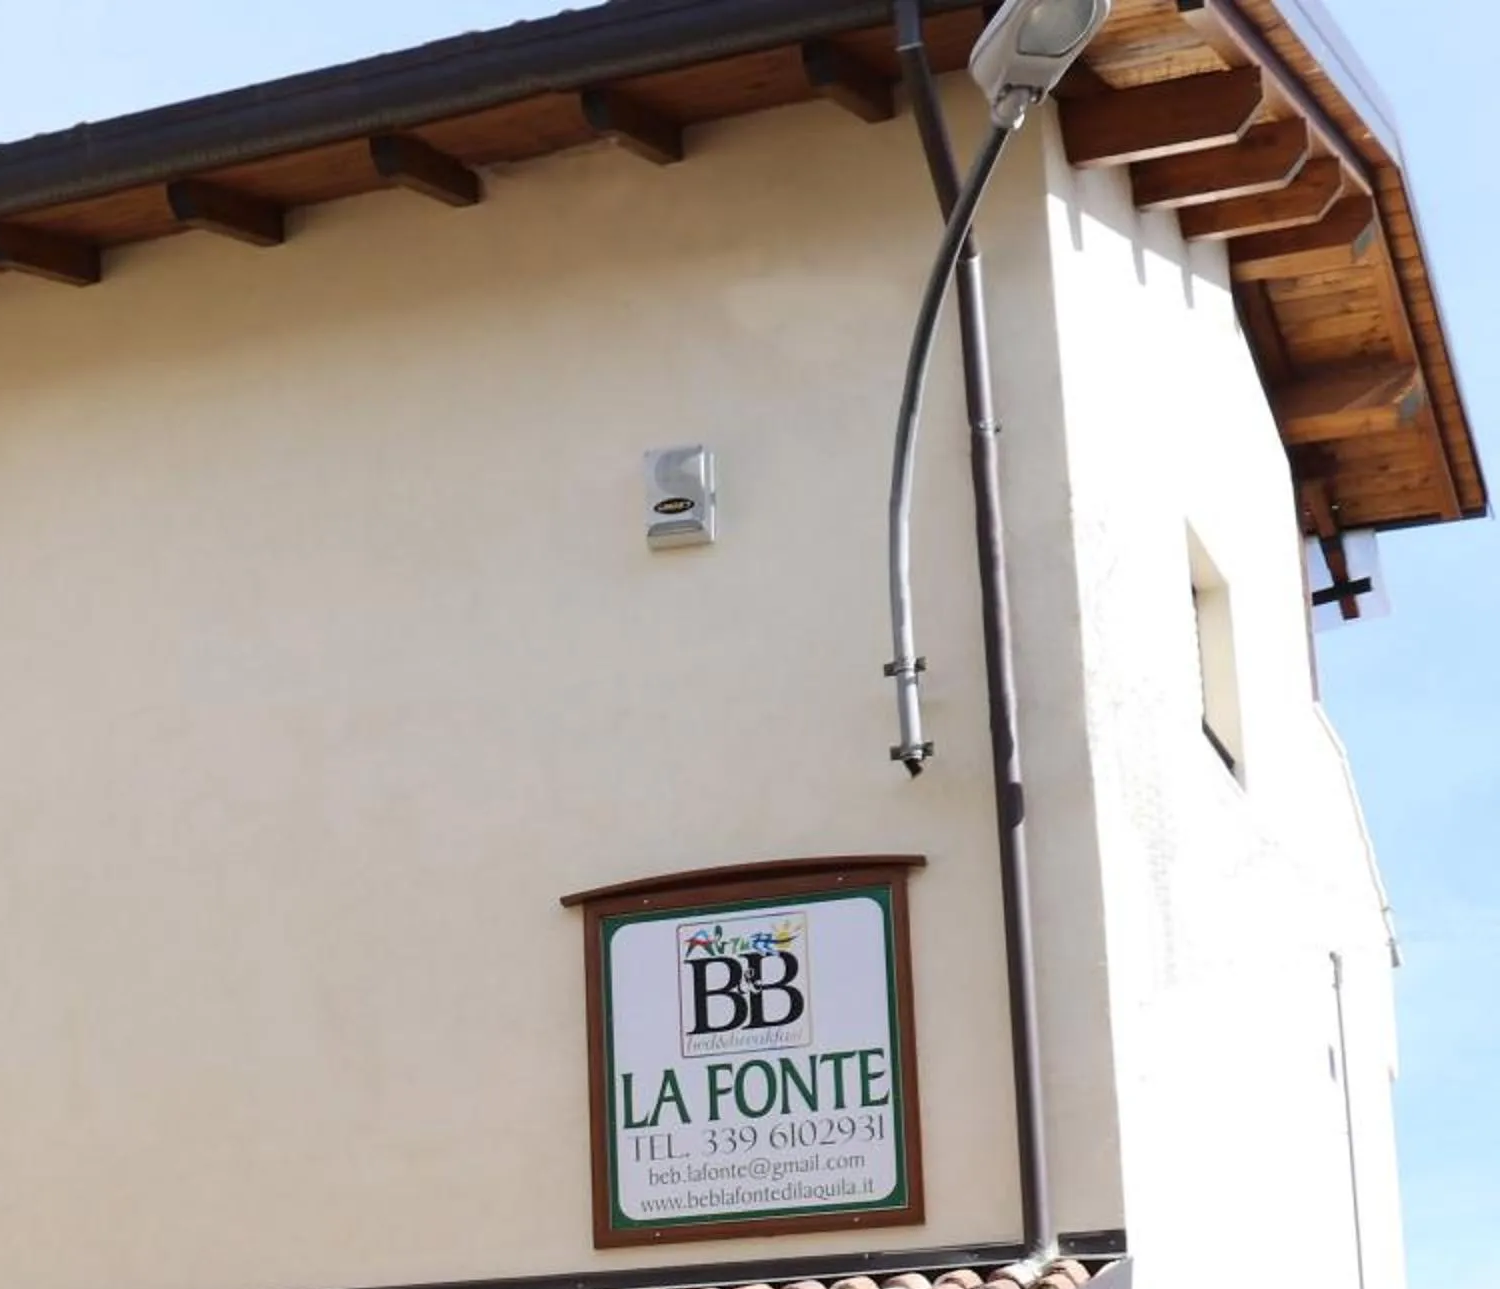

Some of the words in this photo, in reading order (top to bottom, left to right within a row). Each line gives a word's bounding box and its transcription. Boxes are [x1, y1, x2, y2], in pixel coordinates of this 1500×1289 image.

[621, 1068, 692, 1129] LA
[706, 1048, 891, 1121] FONTE
[628, 1133, 691, 1162] TEL.
[702, 1125, 758, 1155] 339
[768, 1114, 885, 1150] 6102931
[648, 1153, 866, 1186] beb.lafonte@gmail.com
[640, 1177, 875, 1213] www.beblafontedilaquila.it
